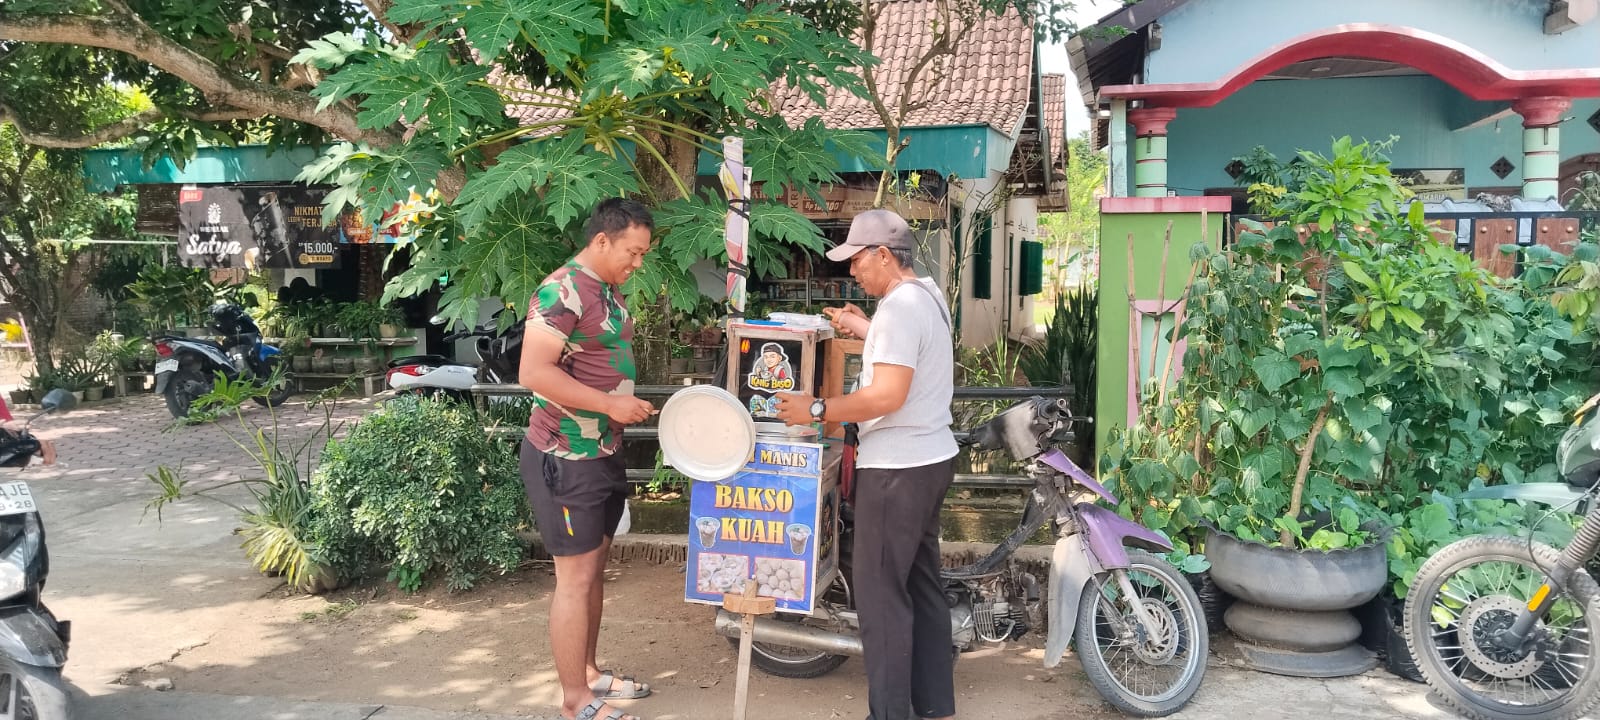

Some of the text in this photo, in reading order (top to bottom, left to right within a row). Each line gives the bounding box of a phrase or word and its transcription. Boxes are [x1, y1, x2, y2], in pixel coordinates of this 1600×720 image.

[294, 206, 323, 216] NIKMAT
[302, 218, 337, 228] TERJGA
[186, 233, 242, 263] Satya
[760, 449, 807, 467] MANIS
[714, 484, 794, 513] BAKSO
[720, 517, 785, 545] KUAH
